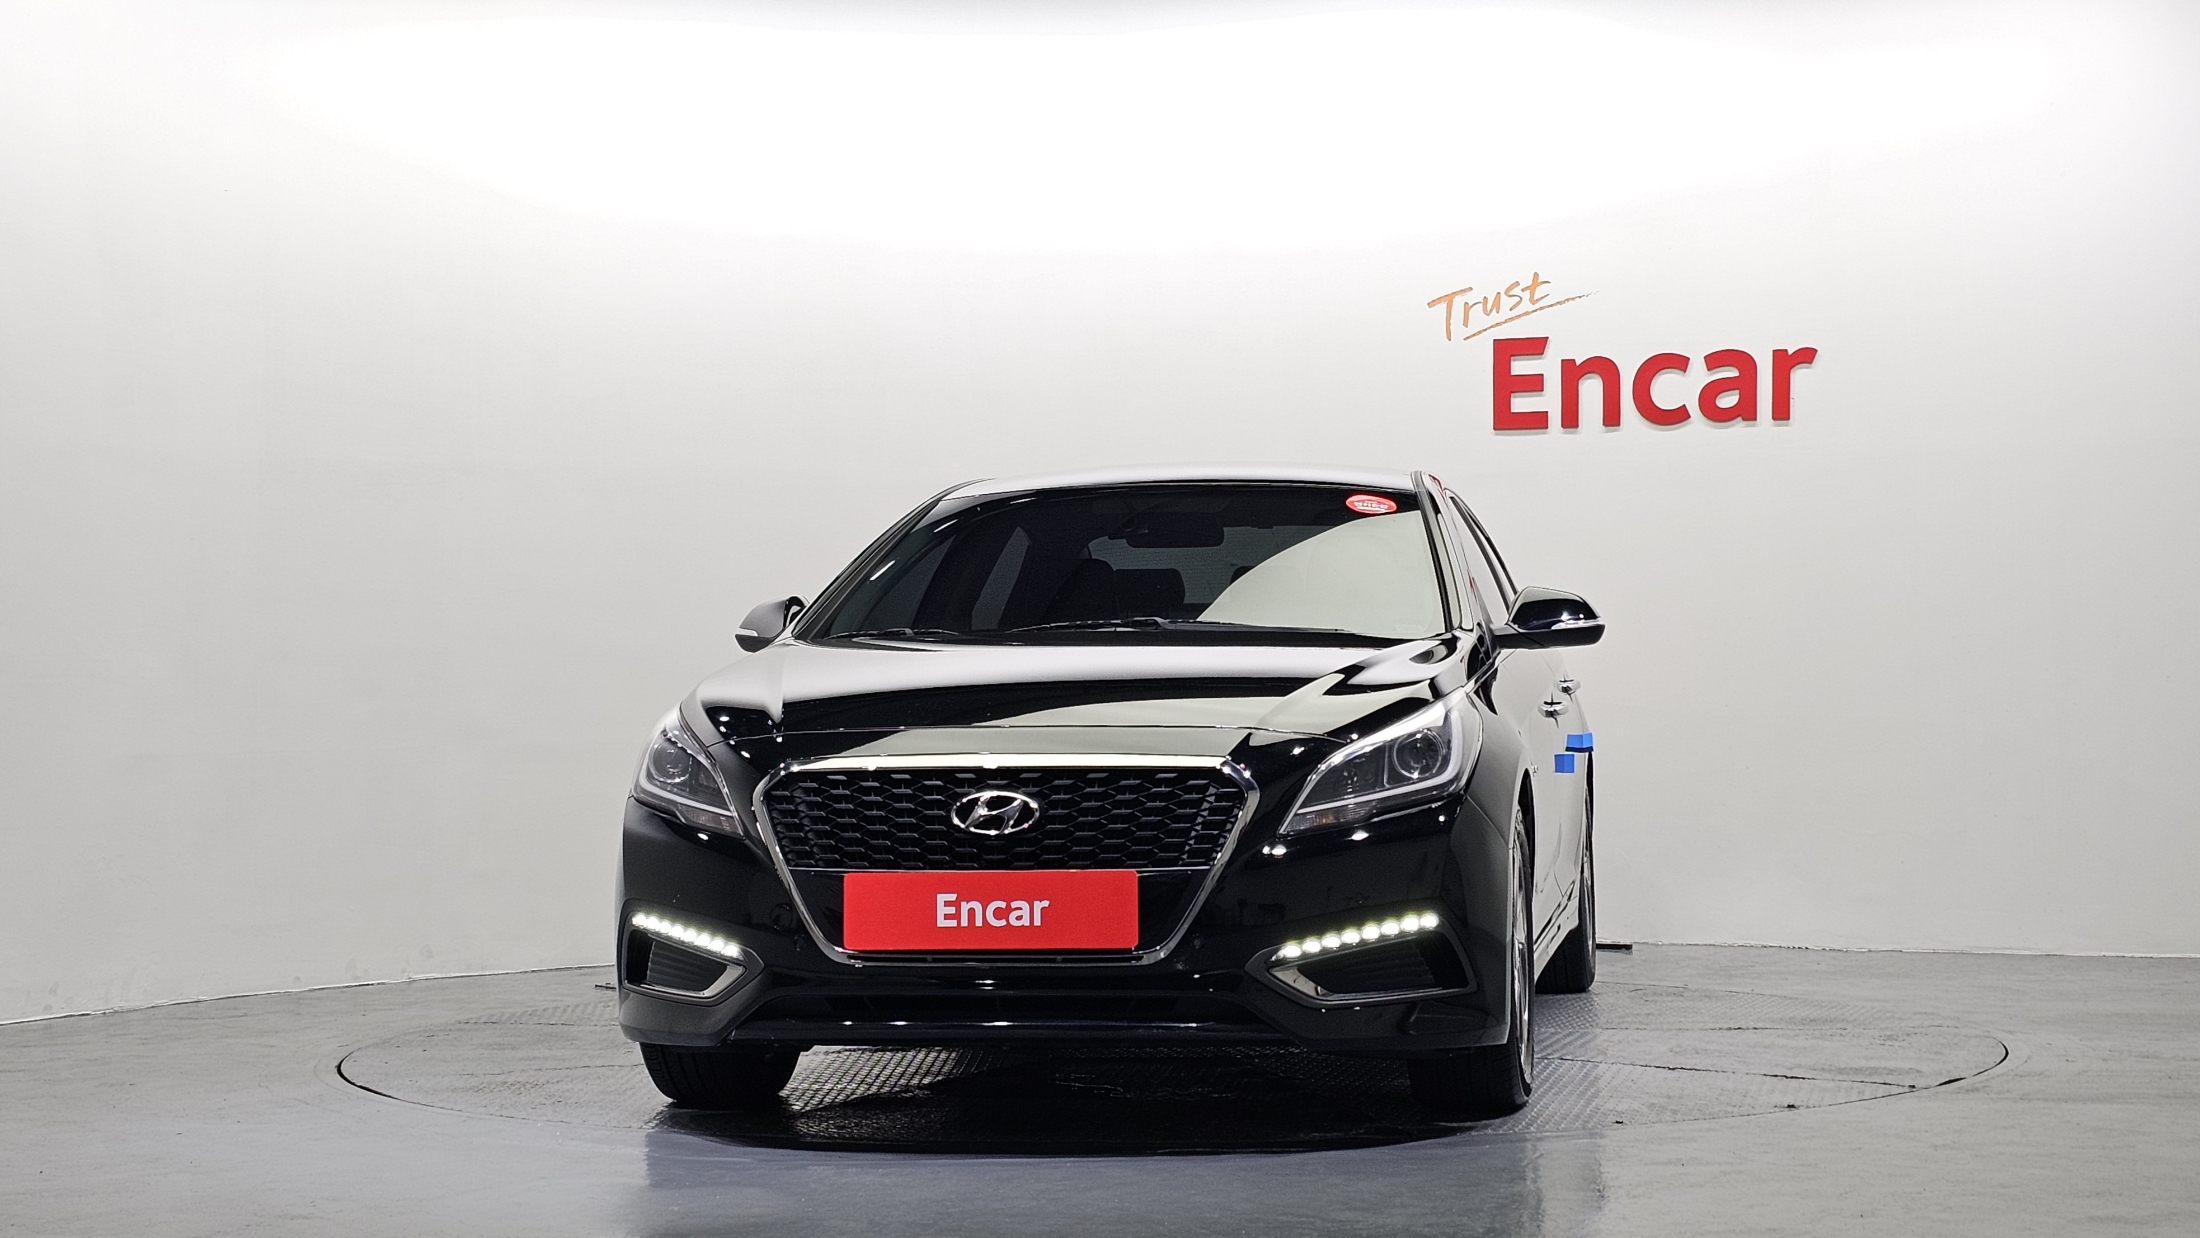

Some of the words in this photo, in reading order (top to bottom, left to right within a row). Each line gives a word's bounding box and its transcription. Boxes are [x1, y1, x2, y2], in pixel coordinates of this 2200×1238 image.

[1427, 272, 1551, 341] Trust
[1493, 337, 1818, 431] Encar
[936, 893, 1050, 928] Encar
